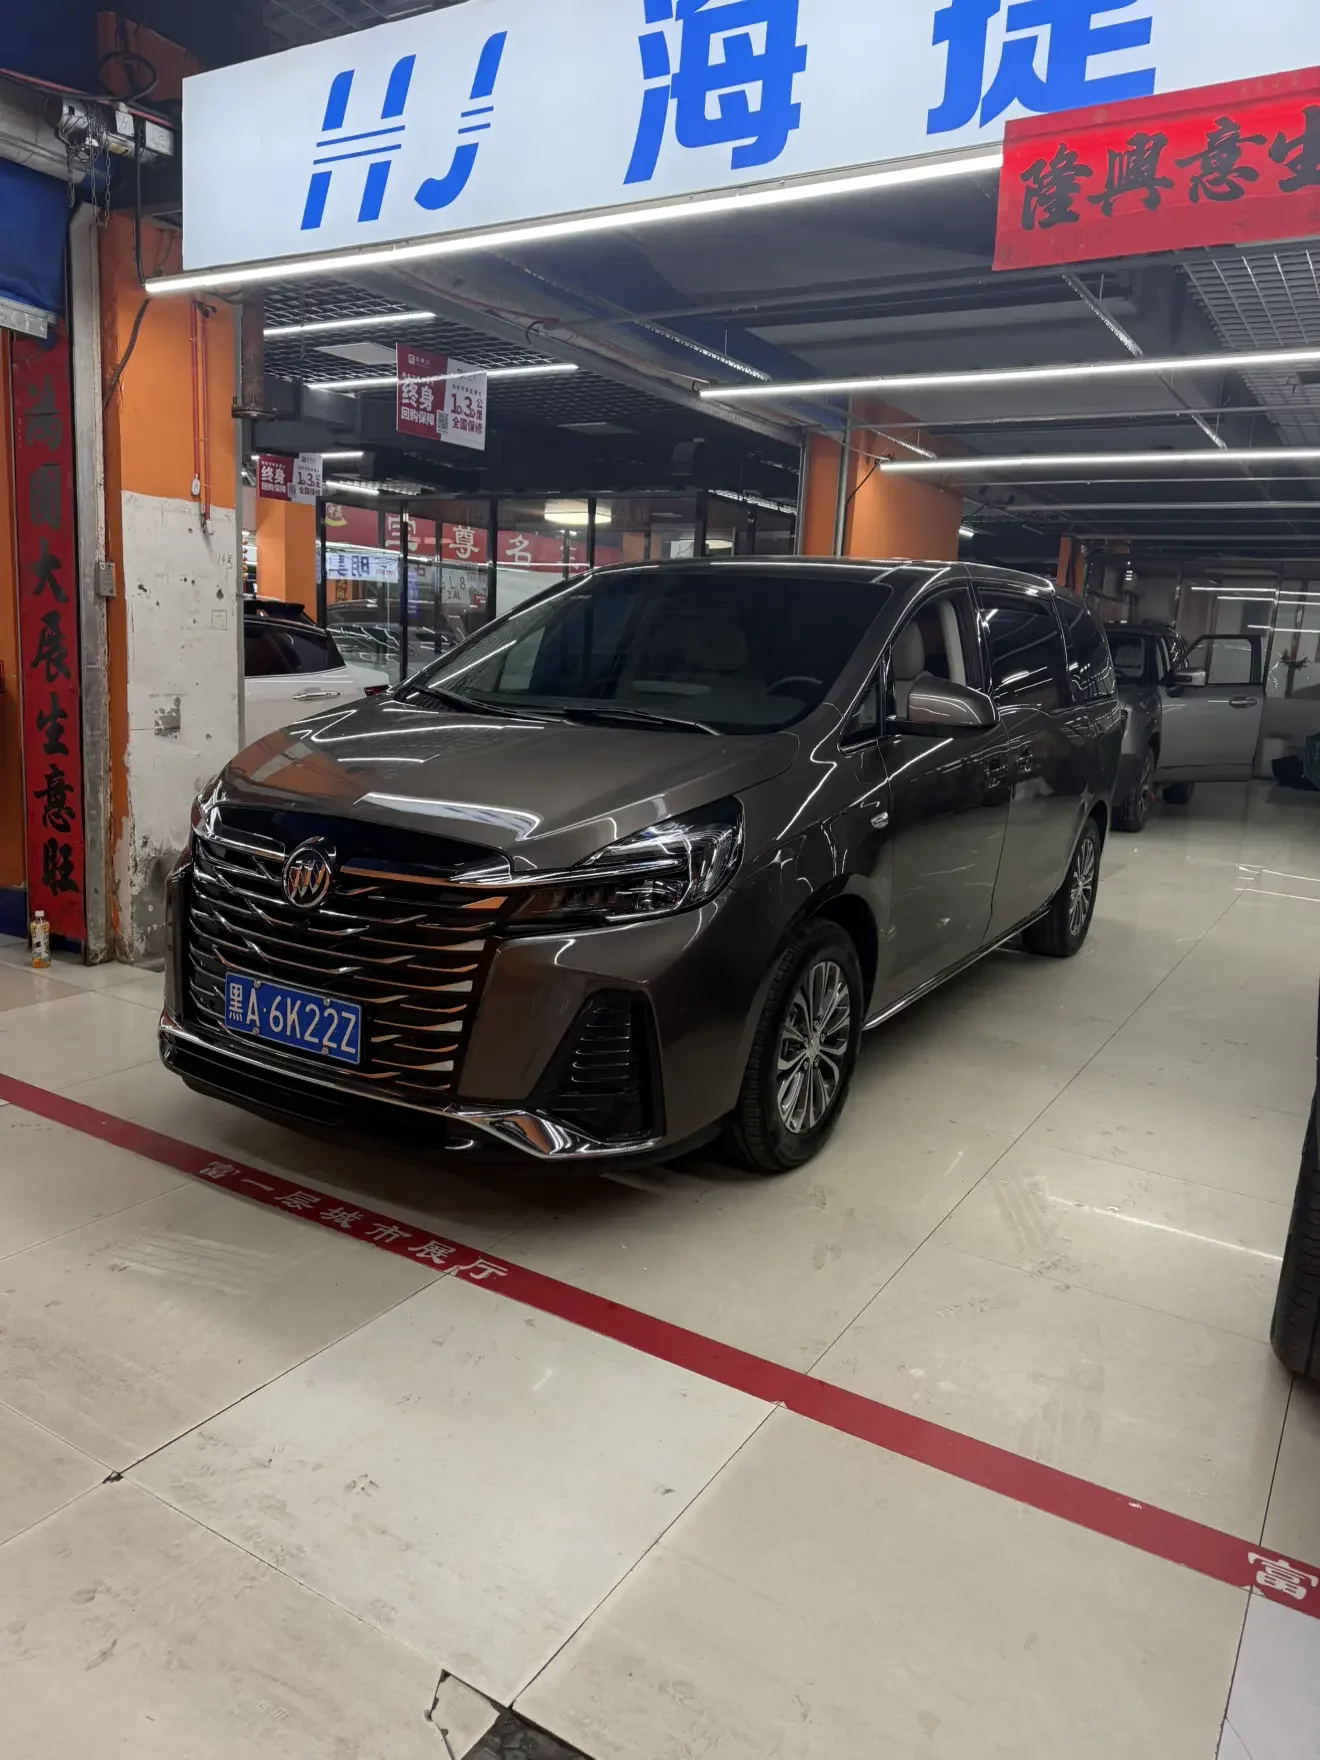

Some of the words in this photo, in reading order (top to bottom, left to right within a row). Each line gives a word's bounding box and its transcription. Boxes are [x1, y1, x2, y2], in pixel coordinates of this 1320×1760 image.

[300, 31, 508, 231] HJ
[401, 406, 435, 426] 回购保障
[452, 416, 483, 434] 全国保修
[1248, 1552, 1319, 1600] 富
